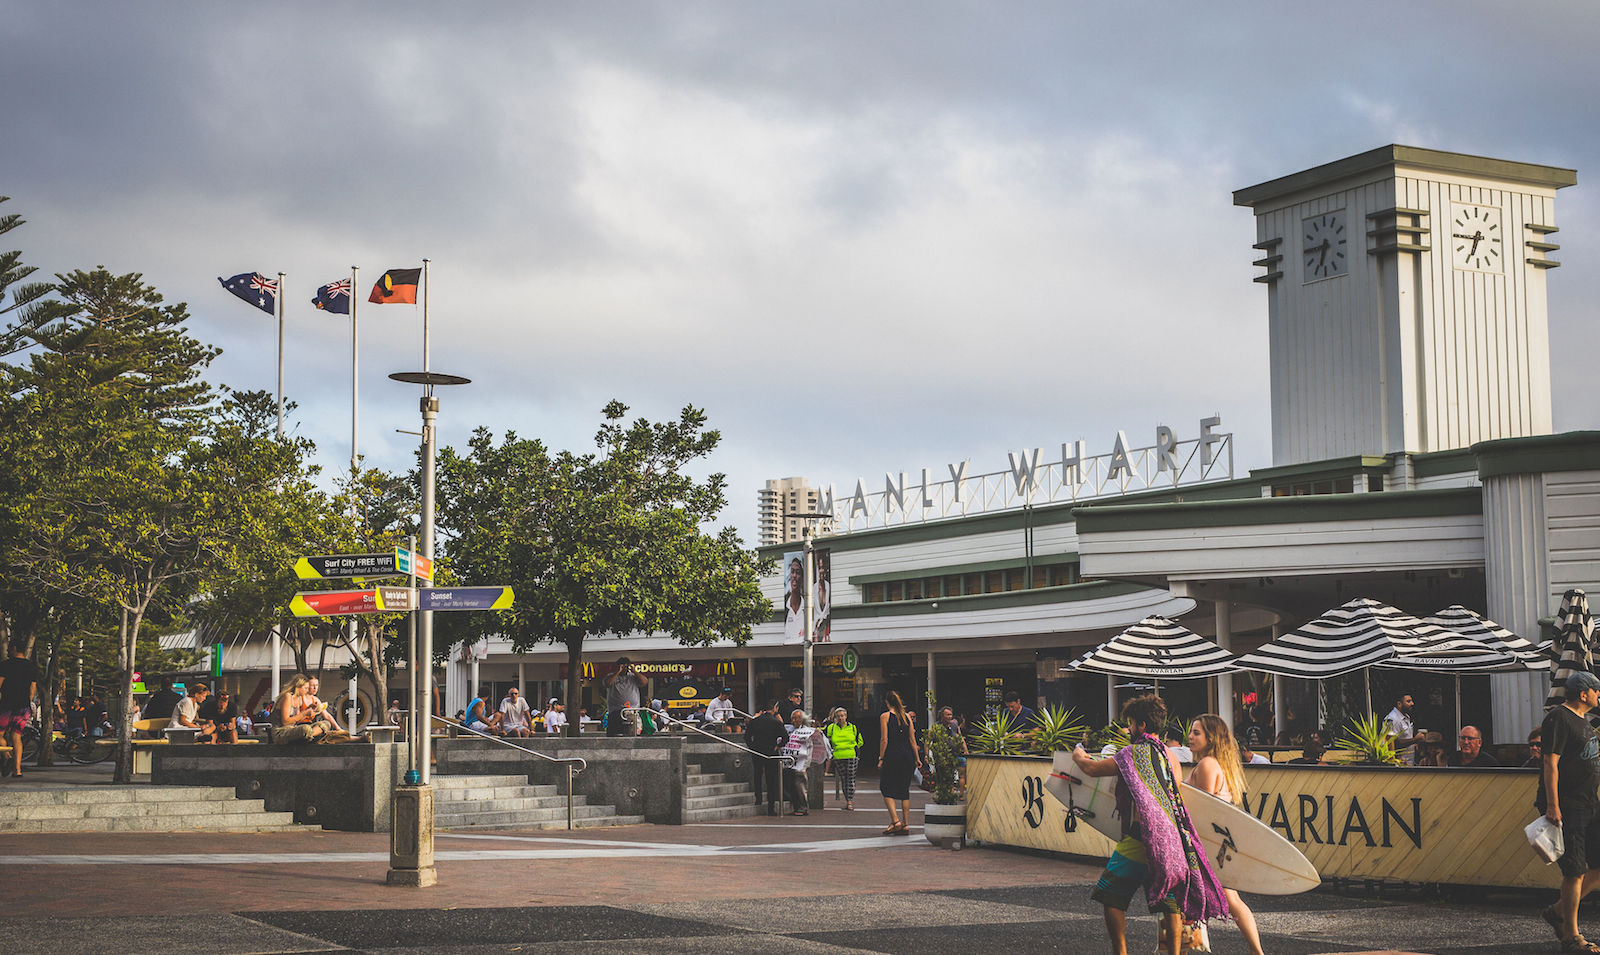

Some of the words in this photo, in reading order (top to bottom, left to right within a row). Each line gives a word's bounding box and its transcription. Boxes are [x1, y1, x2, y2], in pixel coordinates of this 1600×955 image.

[817, 460, 971, 518] MANLY
[1008, 416, 1221, 496] WHARF
[324, 559, 340, 567] Surf
[341, 558, 356, 568] City
[357, 558, 375, 566] FREE
[430, 592, 452, 600] Sunset
[846, 654, 853, 668] F
[1413, 657, 1456, 665] BAVARIAN
[1242, 791, 1422, 849] VARIAN
